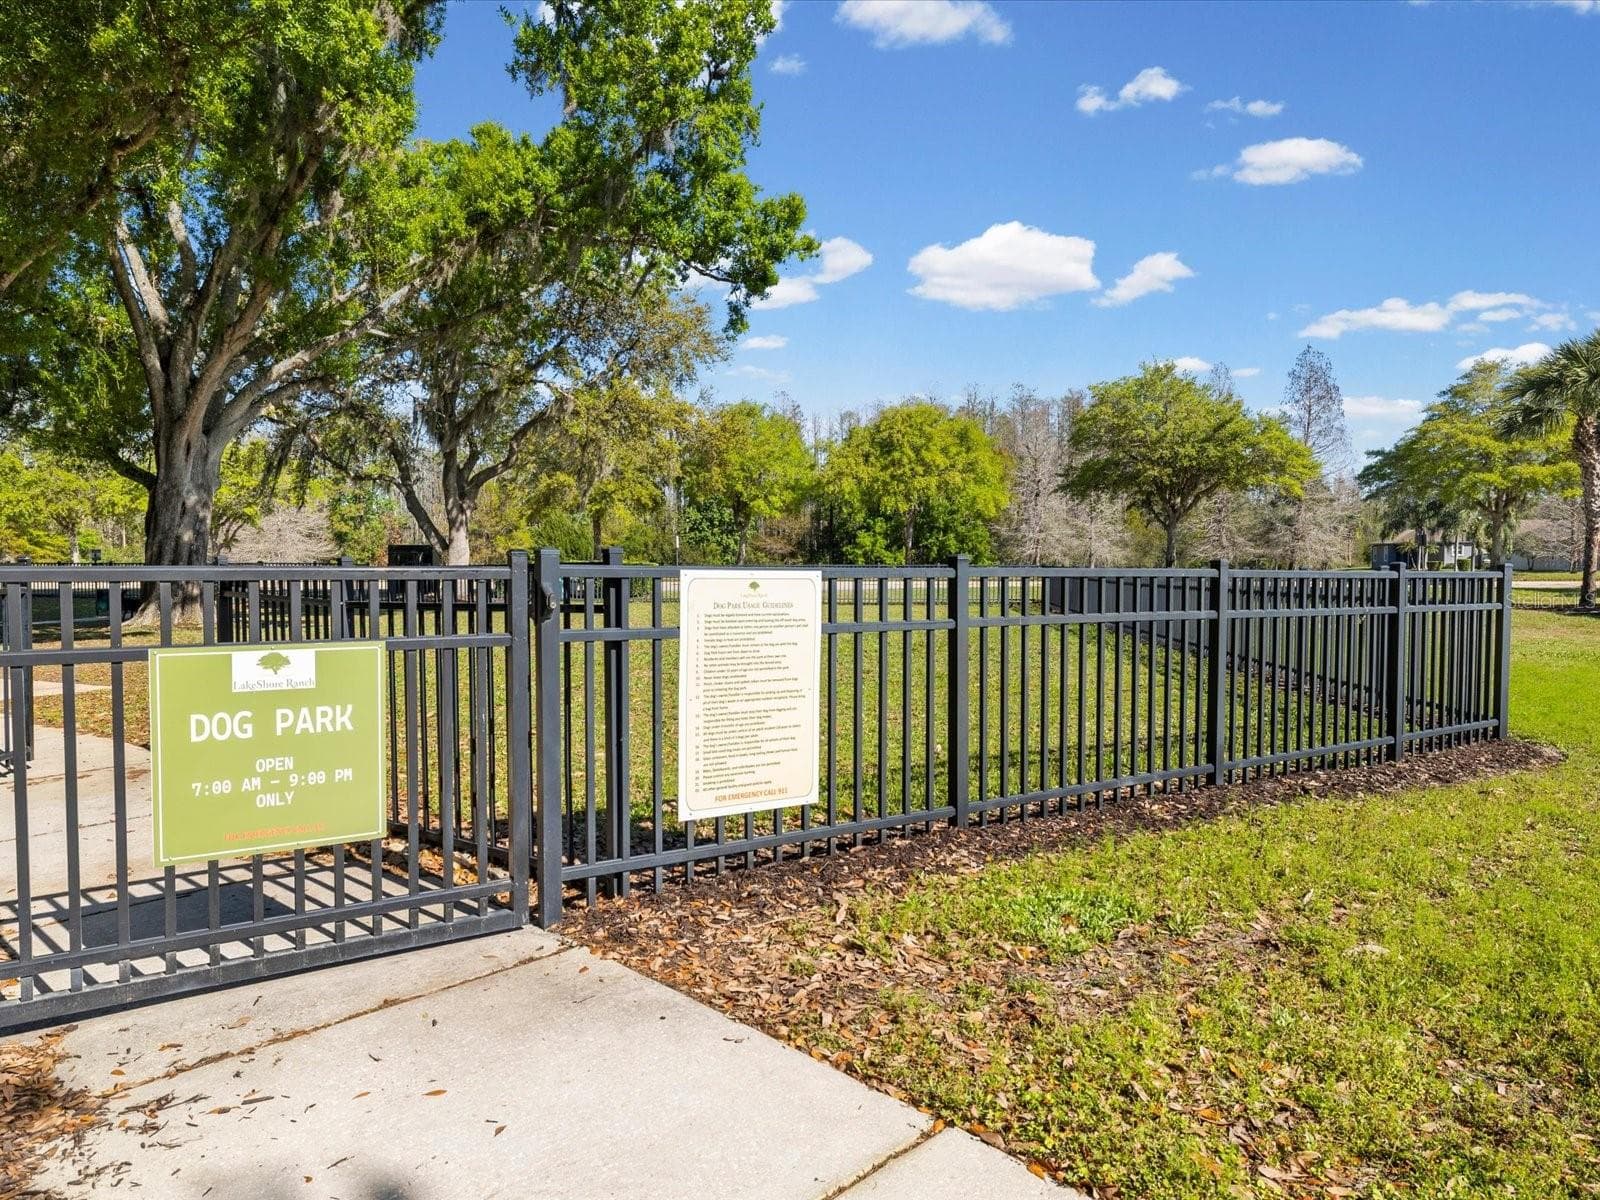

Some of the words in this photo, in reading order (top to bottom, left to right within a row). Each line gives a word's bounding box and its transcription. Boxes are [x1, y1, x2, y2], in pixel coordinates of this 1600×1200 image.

[233, 680, 284, 690] LakeShore
[286, 677, 316, 688] Ranch
[190, 710, 253, 743] DOG
[275, 704, 354, 737] PARK
[255, 756, 294, 773] OPEN
[191, 779, 232, 797] 7:00
[241, 776, 261, 792] AM
[289, 770, 326, 788] 9:00
[334, 768, 353, 783] PM
[255, 790, 295, 808] ONLY
